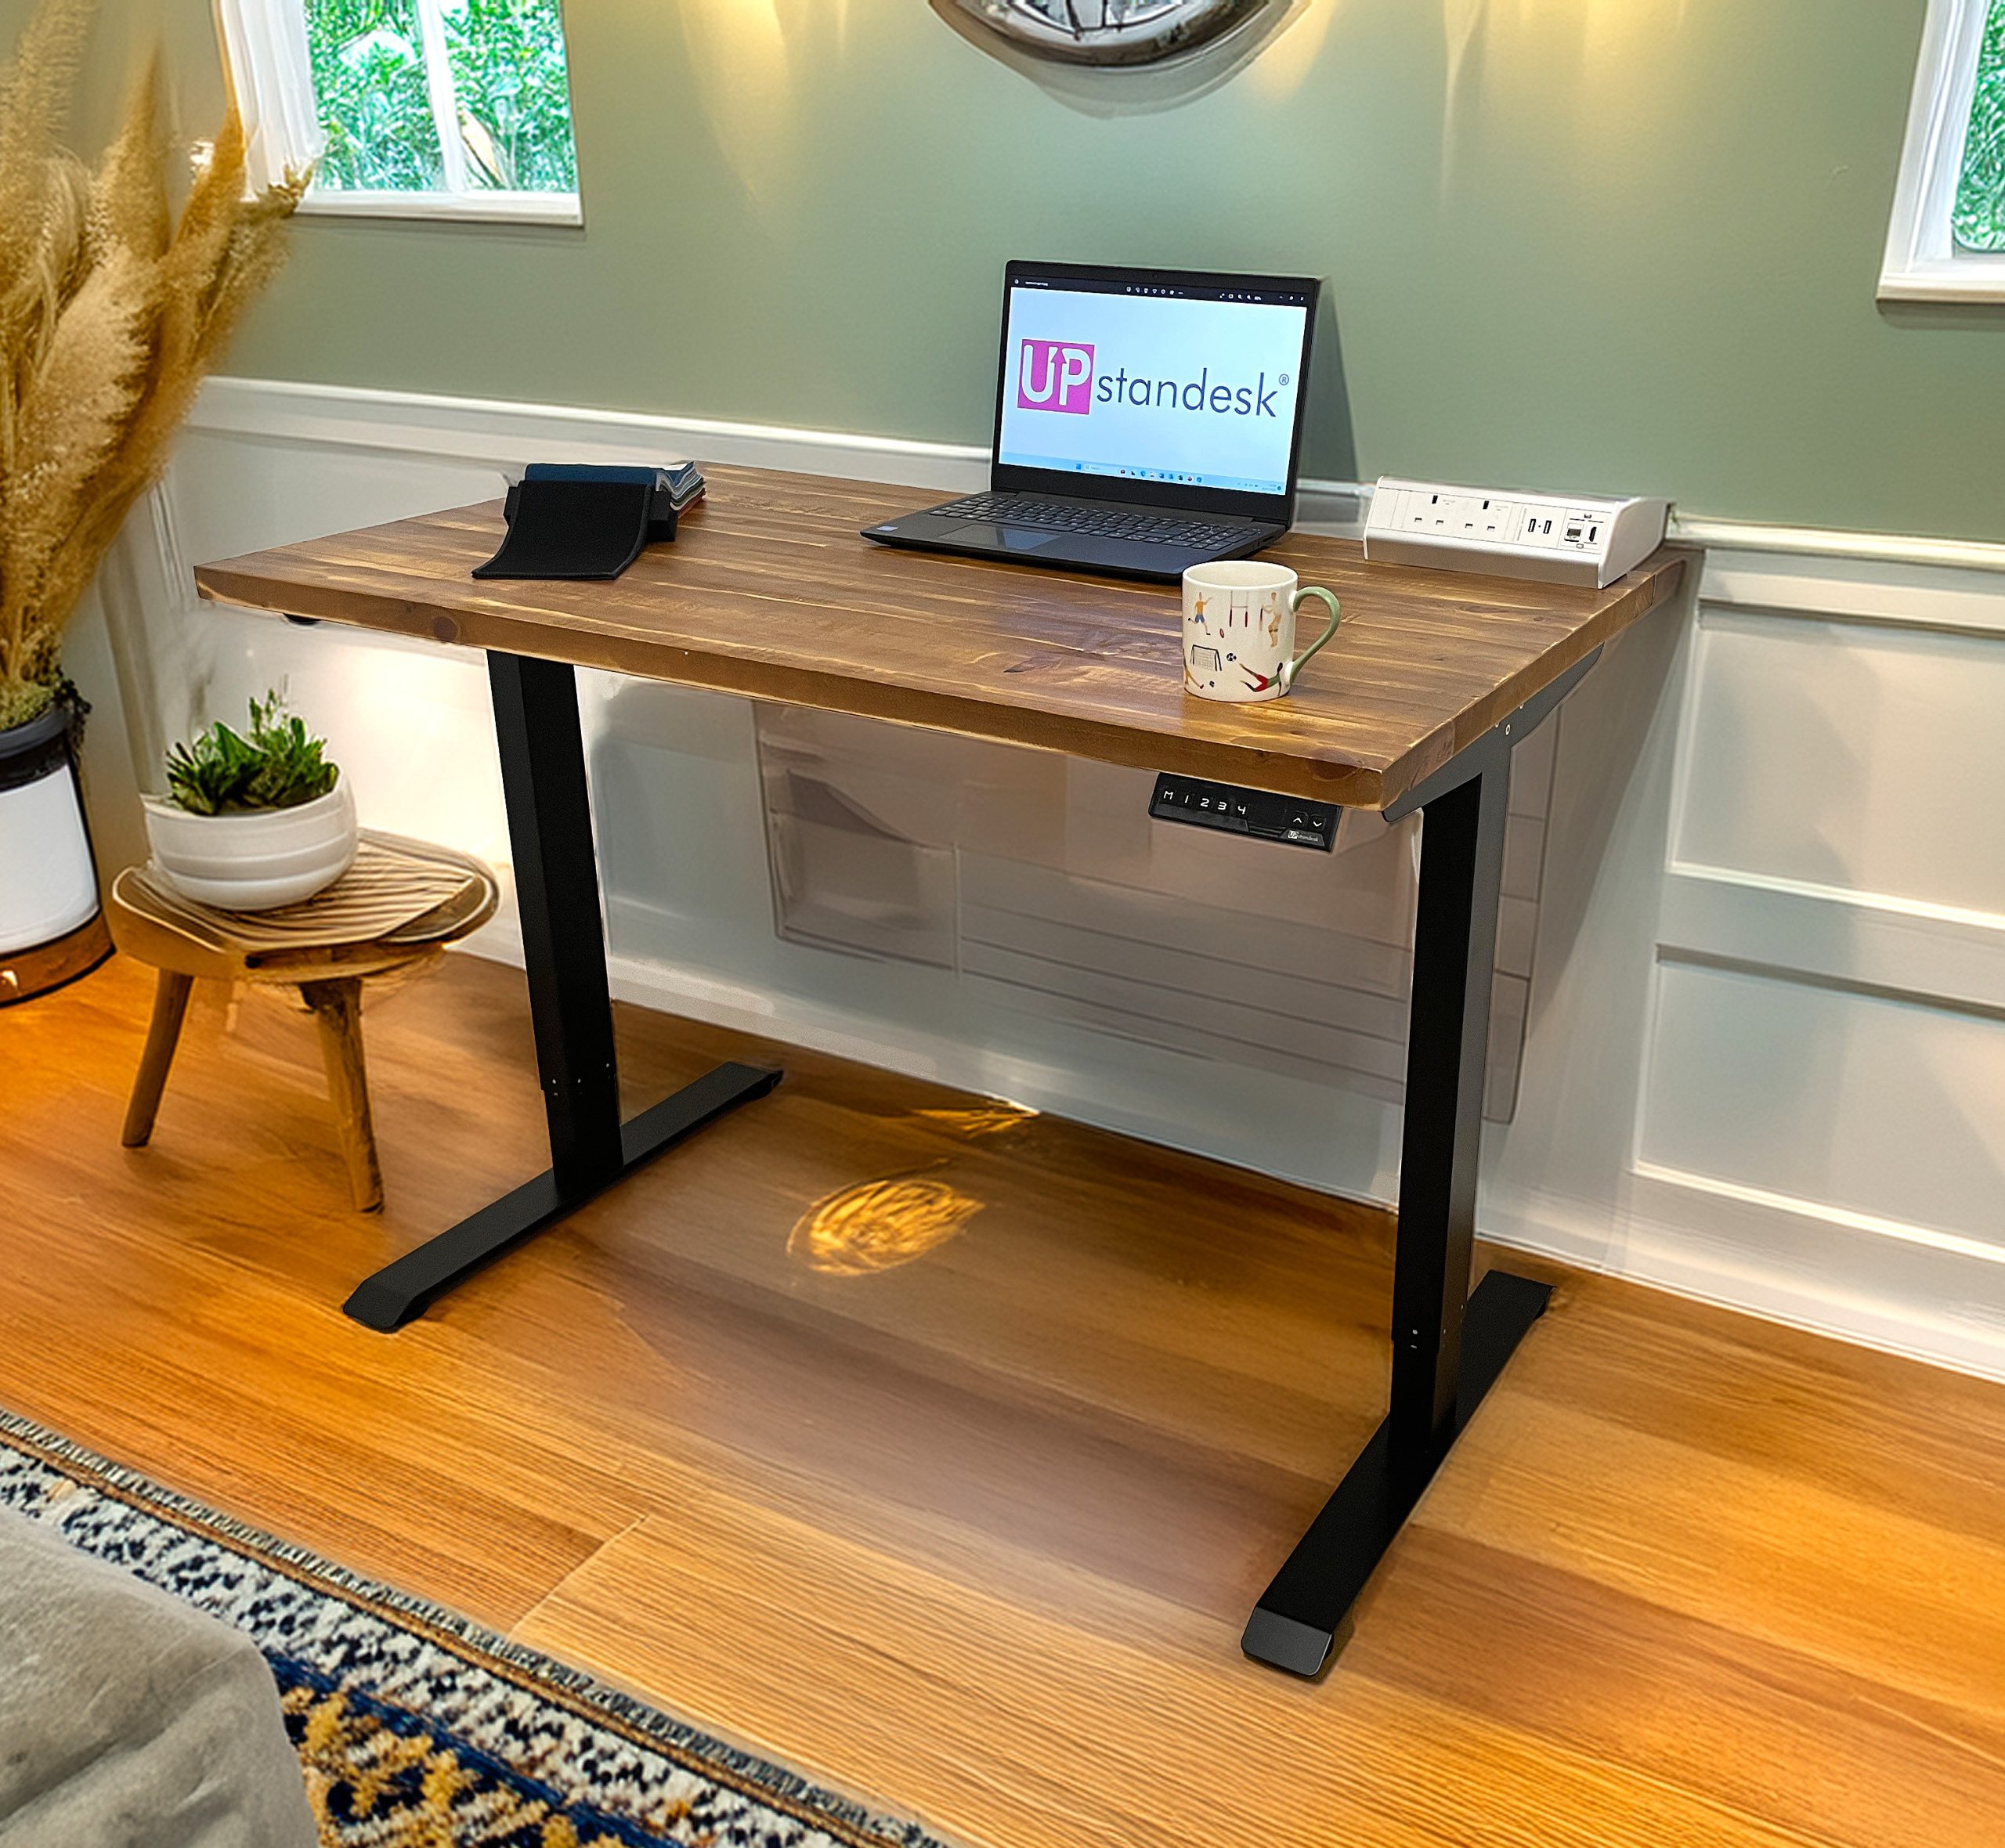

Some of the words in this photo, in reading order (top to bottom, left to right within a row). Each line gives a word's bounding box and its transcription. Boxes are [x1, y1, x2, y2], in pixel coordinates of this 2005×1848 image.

[1021, 344, 1091, 406] UP
[1163, 790, 1174, 800] M
[1184, 795, 1190, 803] 1
[1200, 797, 1210, 807] 2
[1217, 801, 1227, 810] 3
[1237, 805, 1246, 815] 4
